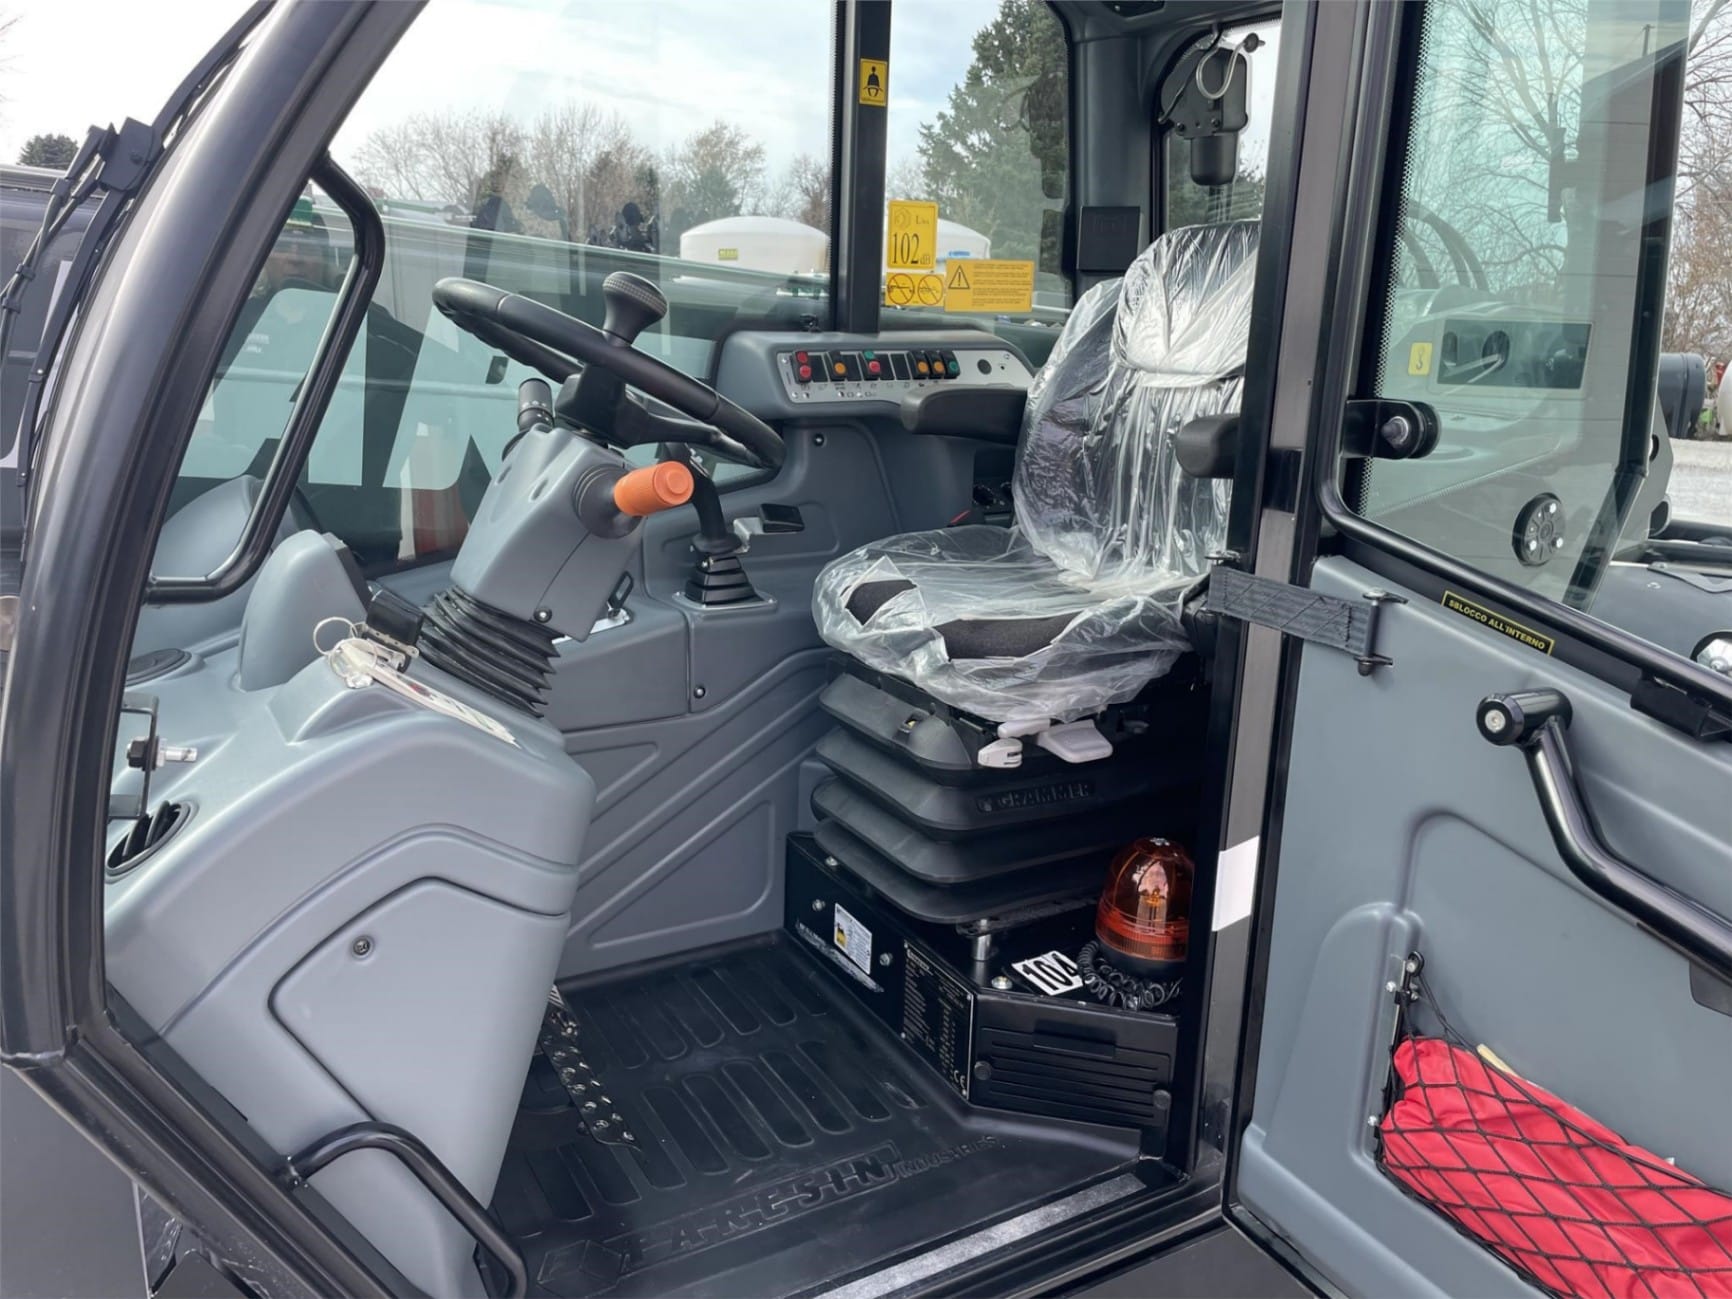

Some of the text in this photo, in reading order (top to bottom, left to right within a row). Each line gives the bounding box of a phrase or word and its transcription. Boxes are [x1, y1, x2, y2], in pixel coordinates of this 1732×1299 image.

[892, 231, 920, 264] 102
[1448, 599, 1546, 650] SBLOCCO ALL'INTERNO
